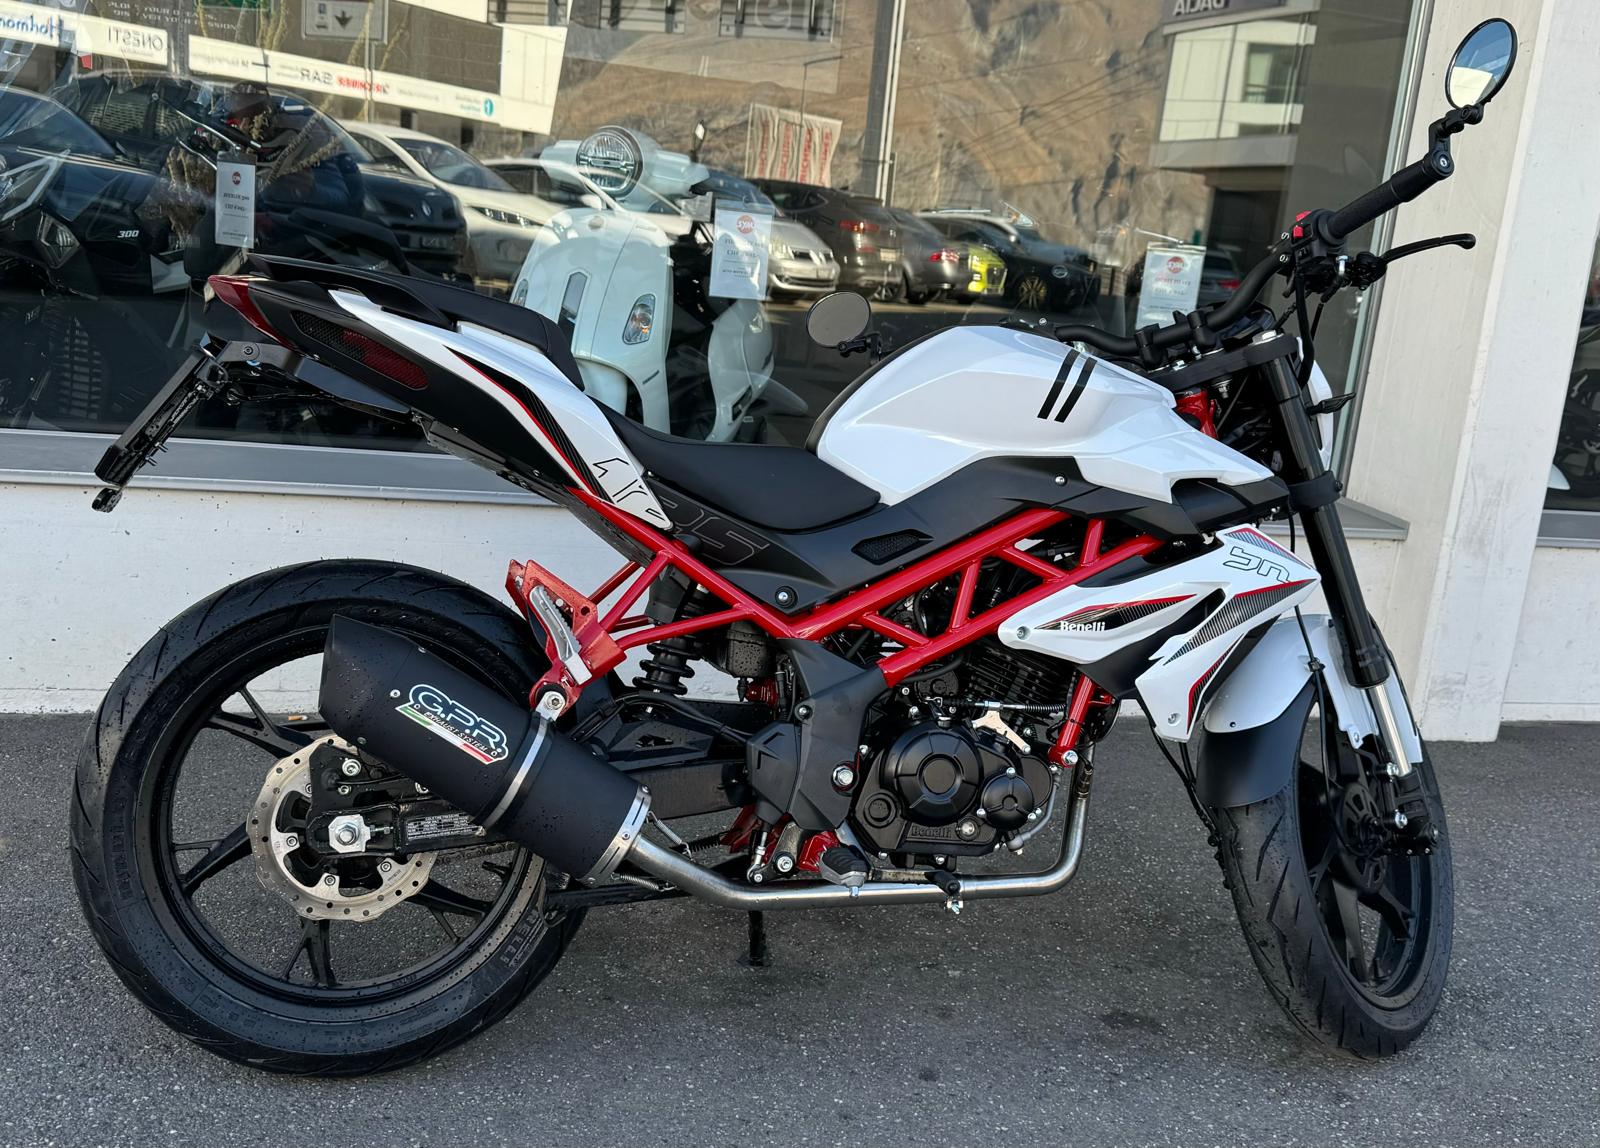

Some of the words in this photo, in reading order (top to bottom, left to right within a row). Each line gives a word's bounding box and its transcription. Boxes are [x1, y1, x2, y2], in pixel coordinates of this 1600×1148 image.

[117, 230, 140, 238] 300
[1060, 620, 1106, 631] Benelli
[424, 711, 458, 735] EXHAUST
[458, 732, 488, 752] SYSTEM
[499, 908, 539, 964] RELLI
